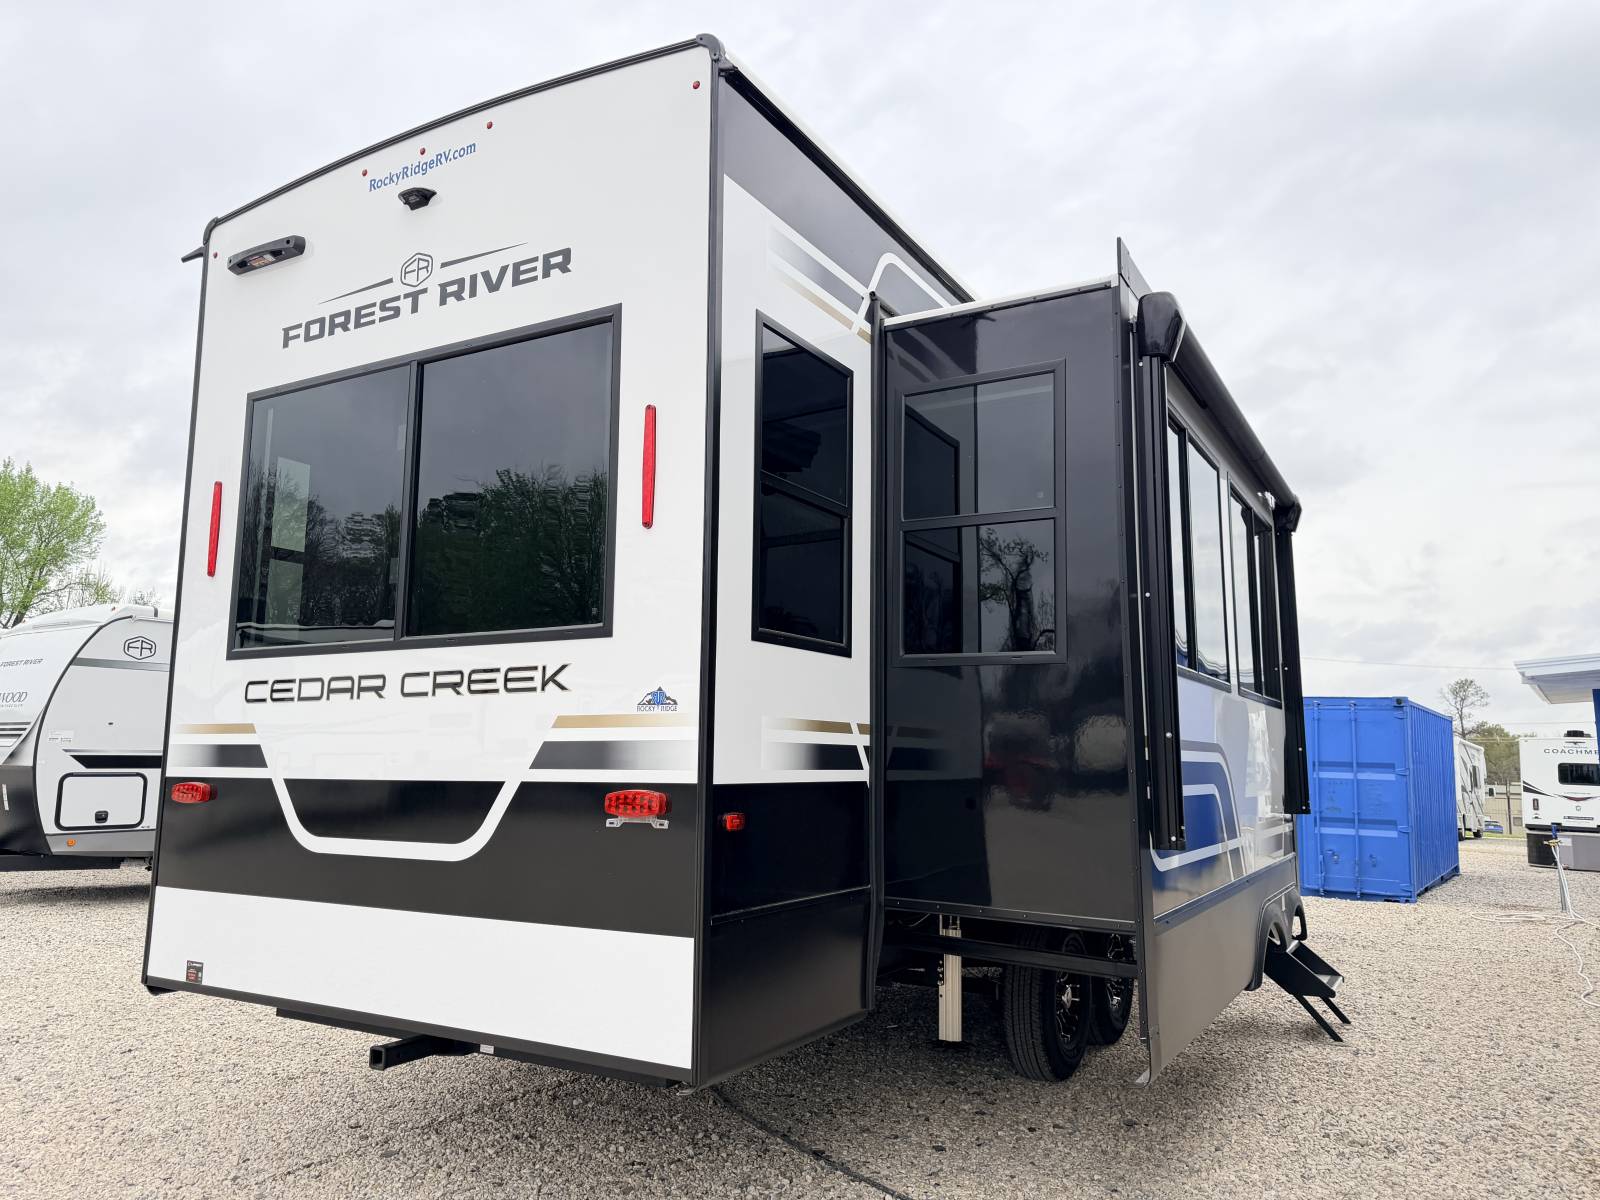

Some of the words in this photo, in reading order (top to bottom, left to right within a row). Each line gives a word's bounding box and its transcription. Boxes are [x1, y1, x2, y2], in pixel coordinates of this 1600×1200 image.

[369, 143, 476, 192] RockyRidgeRV.com
[282, 288, 428, 349] FOREST
[438, 247, 572, 307] RIVER
[244, 674, 386, 703] CEDAR
[400, 663, 572, 697] CREEK
